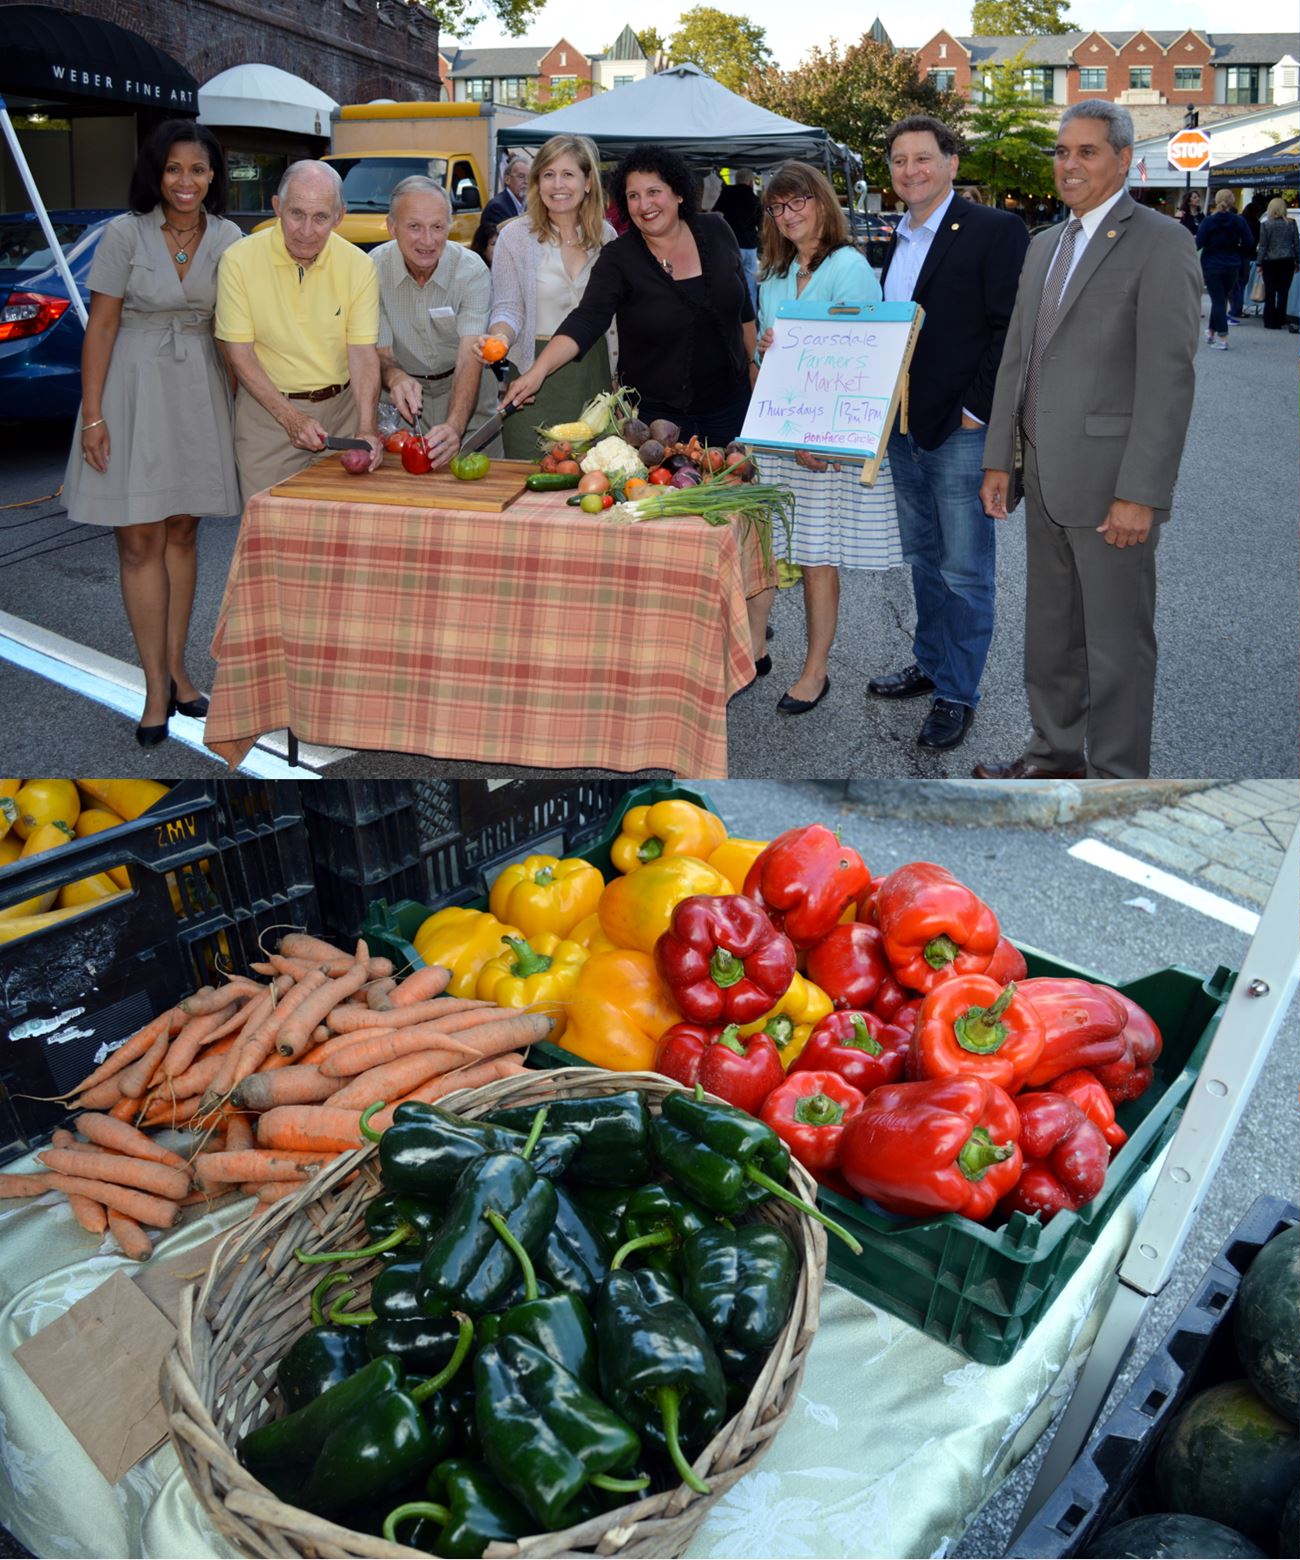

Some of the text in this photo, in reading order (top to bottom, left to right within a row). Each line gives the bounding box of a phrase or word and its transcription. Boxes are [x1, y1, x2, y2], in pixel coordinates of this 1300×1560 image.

[52, 64, 193, 103] WEBER FINE ART
[1171, 141, 1209, 159] STOP
[781, 326, 878, 350] Scarsdale
[797, 349, 870, 372] Farmers
[804, 371, 869, 393] Market
[758, 400, 825, 424] Thursdays
[803, 432, 876, 445] Boniface Circle
